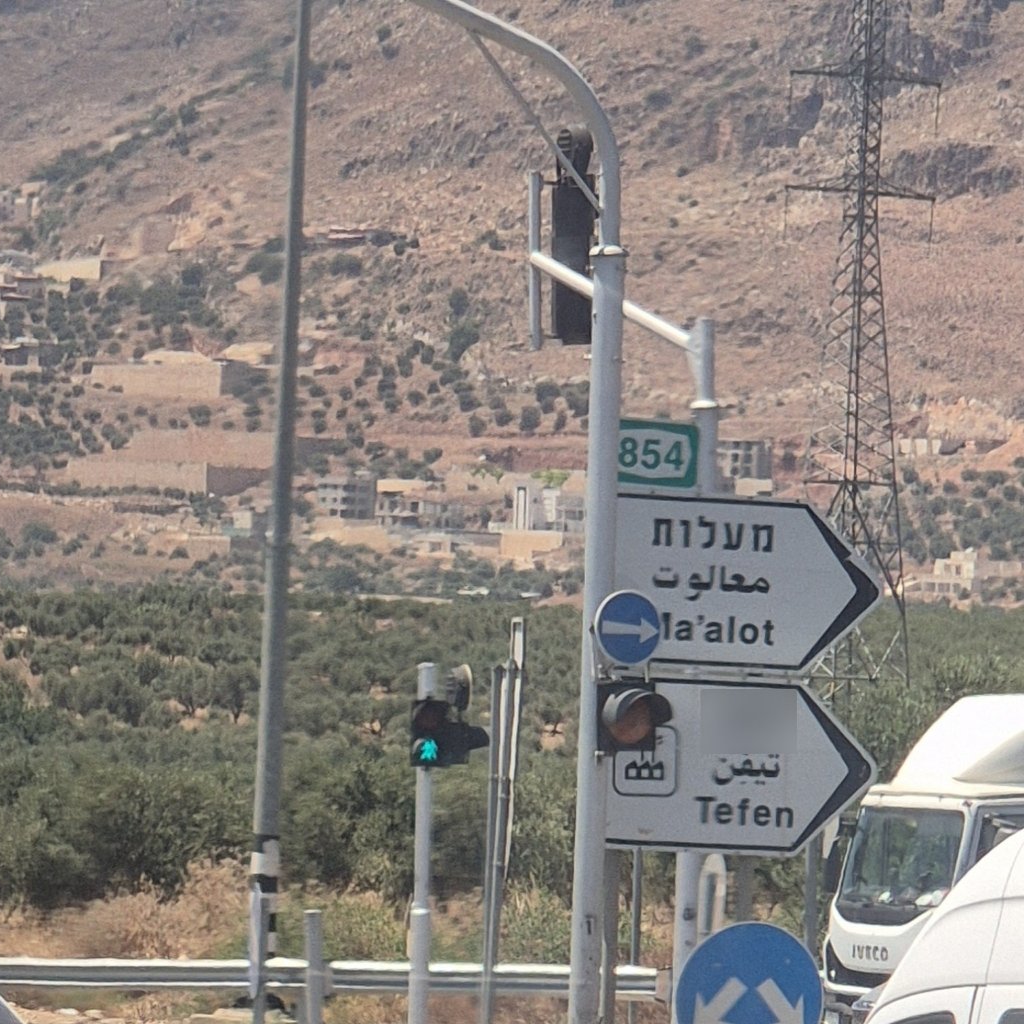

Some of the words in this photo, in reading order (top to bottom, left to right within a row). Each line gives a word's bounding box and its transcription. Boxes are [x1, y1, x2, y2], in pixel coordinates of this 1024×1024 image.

[618, 437, 684, 471] 854
[652, 515, 774, 552] מעלות
[652, 565, 770, 602] معالوت
[694, 796, 794, 828] Tefen
[852, 944, 889, 961] IVECO
